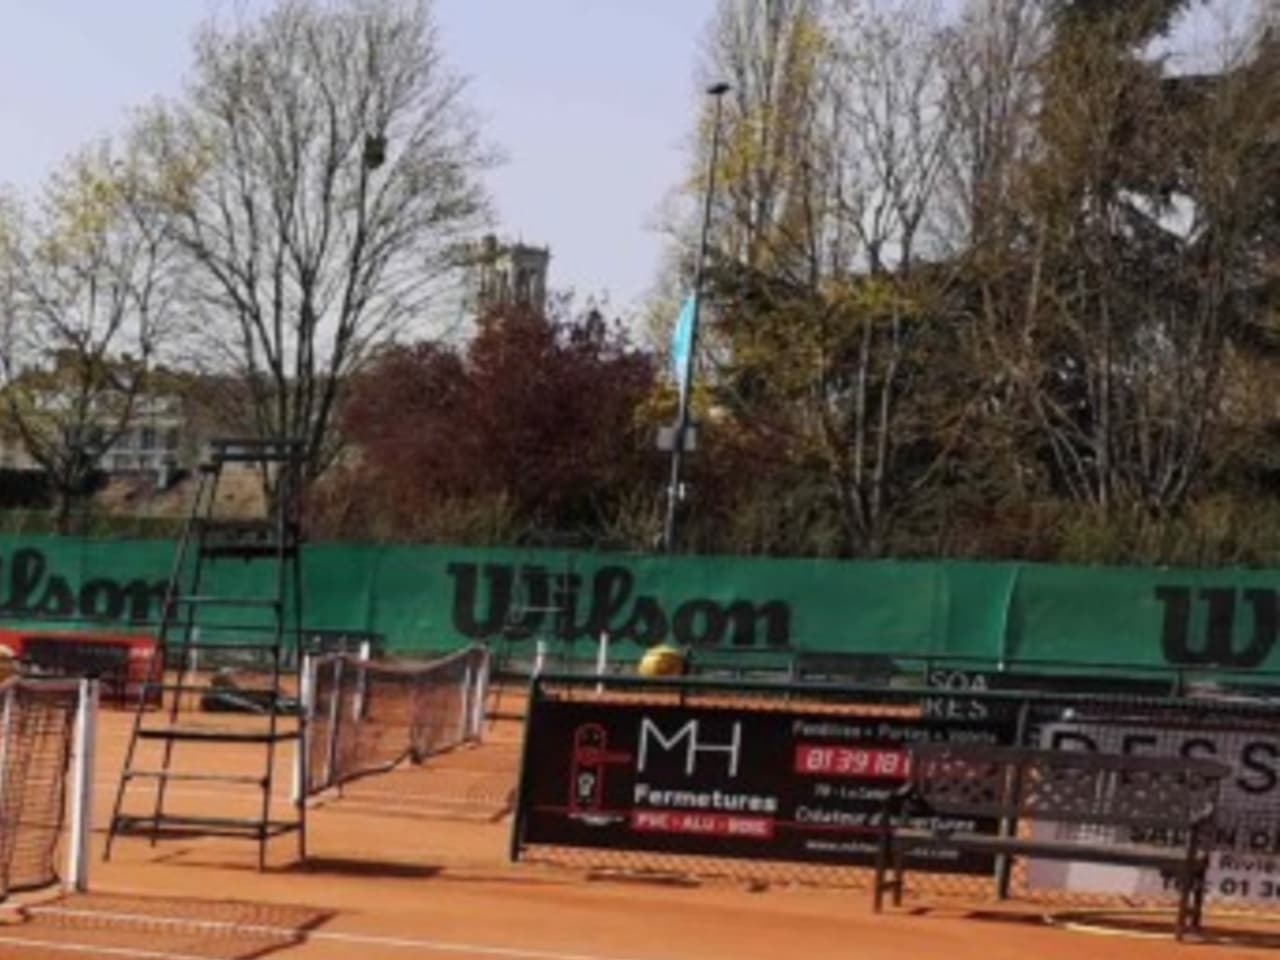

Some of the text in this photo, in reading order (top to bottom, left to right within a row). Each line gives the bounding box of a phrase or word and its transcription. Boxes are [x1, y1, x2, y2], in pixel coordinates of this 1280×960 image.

[447, 562, 792, 645] Wilson
[637, 717, 742, 777] MH
[633, 783, 779, 812] Fermetures
